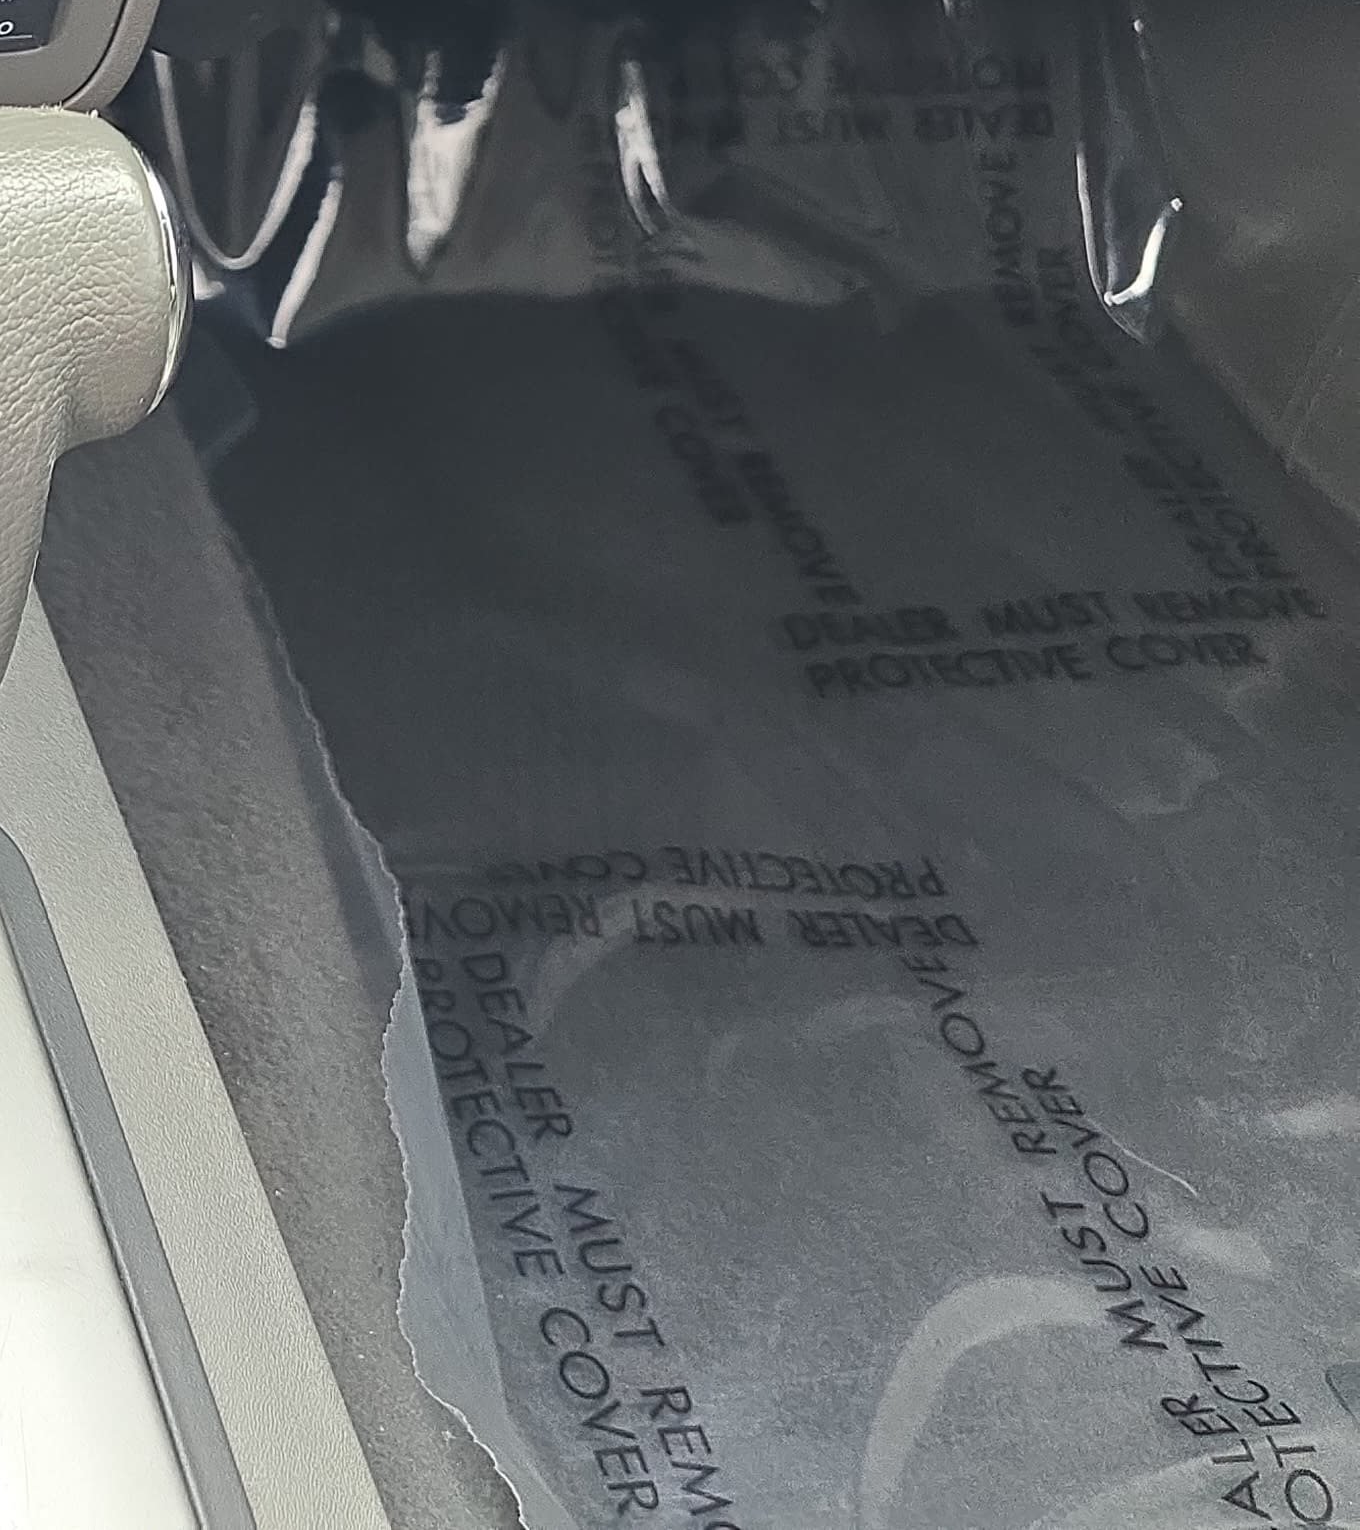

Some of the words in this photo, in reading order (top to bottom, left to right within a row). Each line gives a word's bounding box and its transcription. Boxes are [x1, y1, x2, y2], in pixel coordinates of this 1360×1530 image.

[778, 604, 958, 653] DEALER
[981, 590, 1114, 637] MUST
[805, 642, 1094, 698] PROTECTIVE
[1104, 631, 1270, 669] COVER
[660, 845, 949, 900] PROTECTIVE
[408, 891, 602, 945] REMOV
[632, 898, 765, 947] MUST
[785, 909, 981, 950] DEALER
[905, 958, 1059, 1157] REMOVE
[460, 950, 575, 1144] DEALER
[552, 1181, 667, 1350] MUST
[1022, 1066, 1151, 1241] COVER
[416, 957, 566, 1279] PROTECTIVE
[540, 1307, 659, 1518] COVER
[1040, 1190, 1171, 1352] MUST
